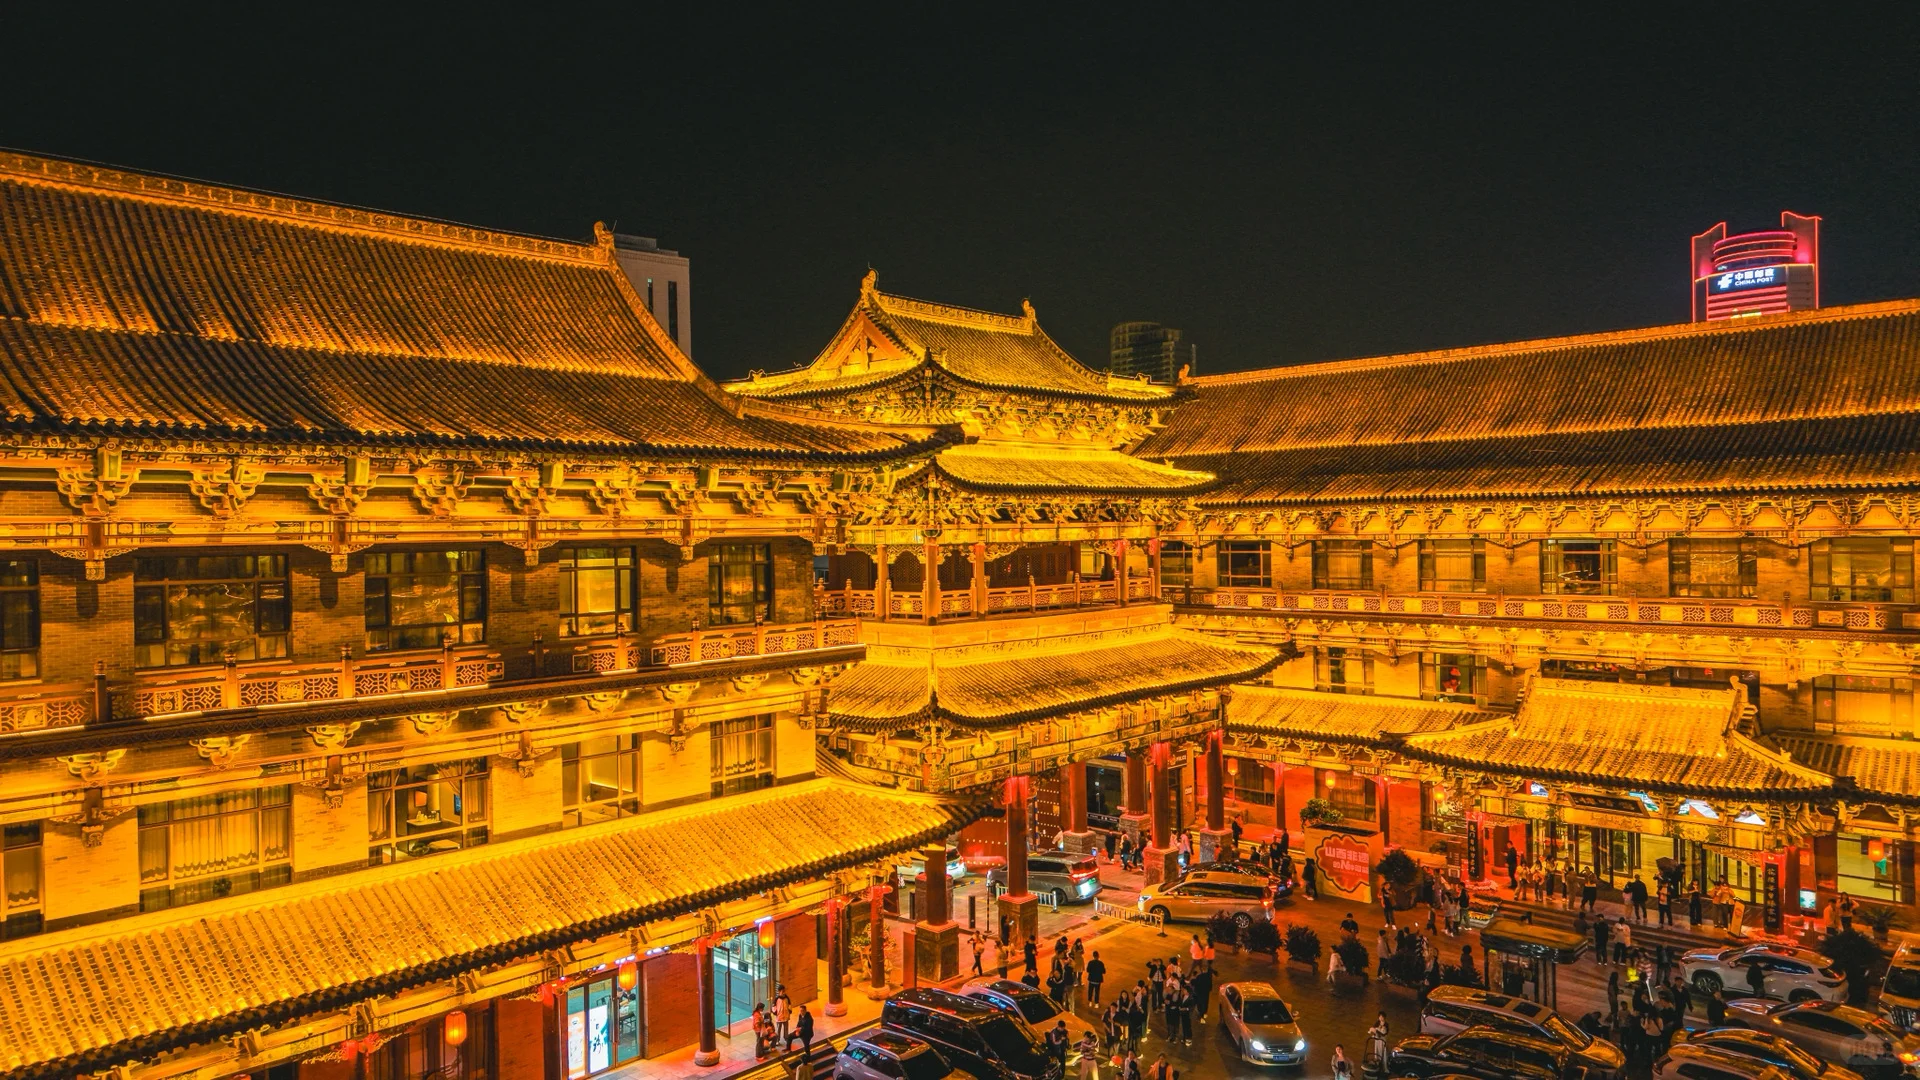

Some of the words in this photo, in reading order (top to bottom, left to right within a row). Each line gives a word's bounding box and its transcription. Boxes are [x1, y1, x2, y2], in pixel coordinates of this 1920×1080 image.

[1735, 268, 1774, 280] 中国邮政
[1757, 276, 1774, 284] POST
